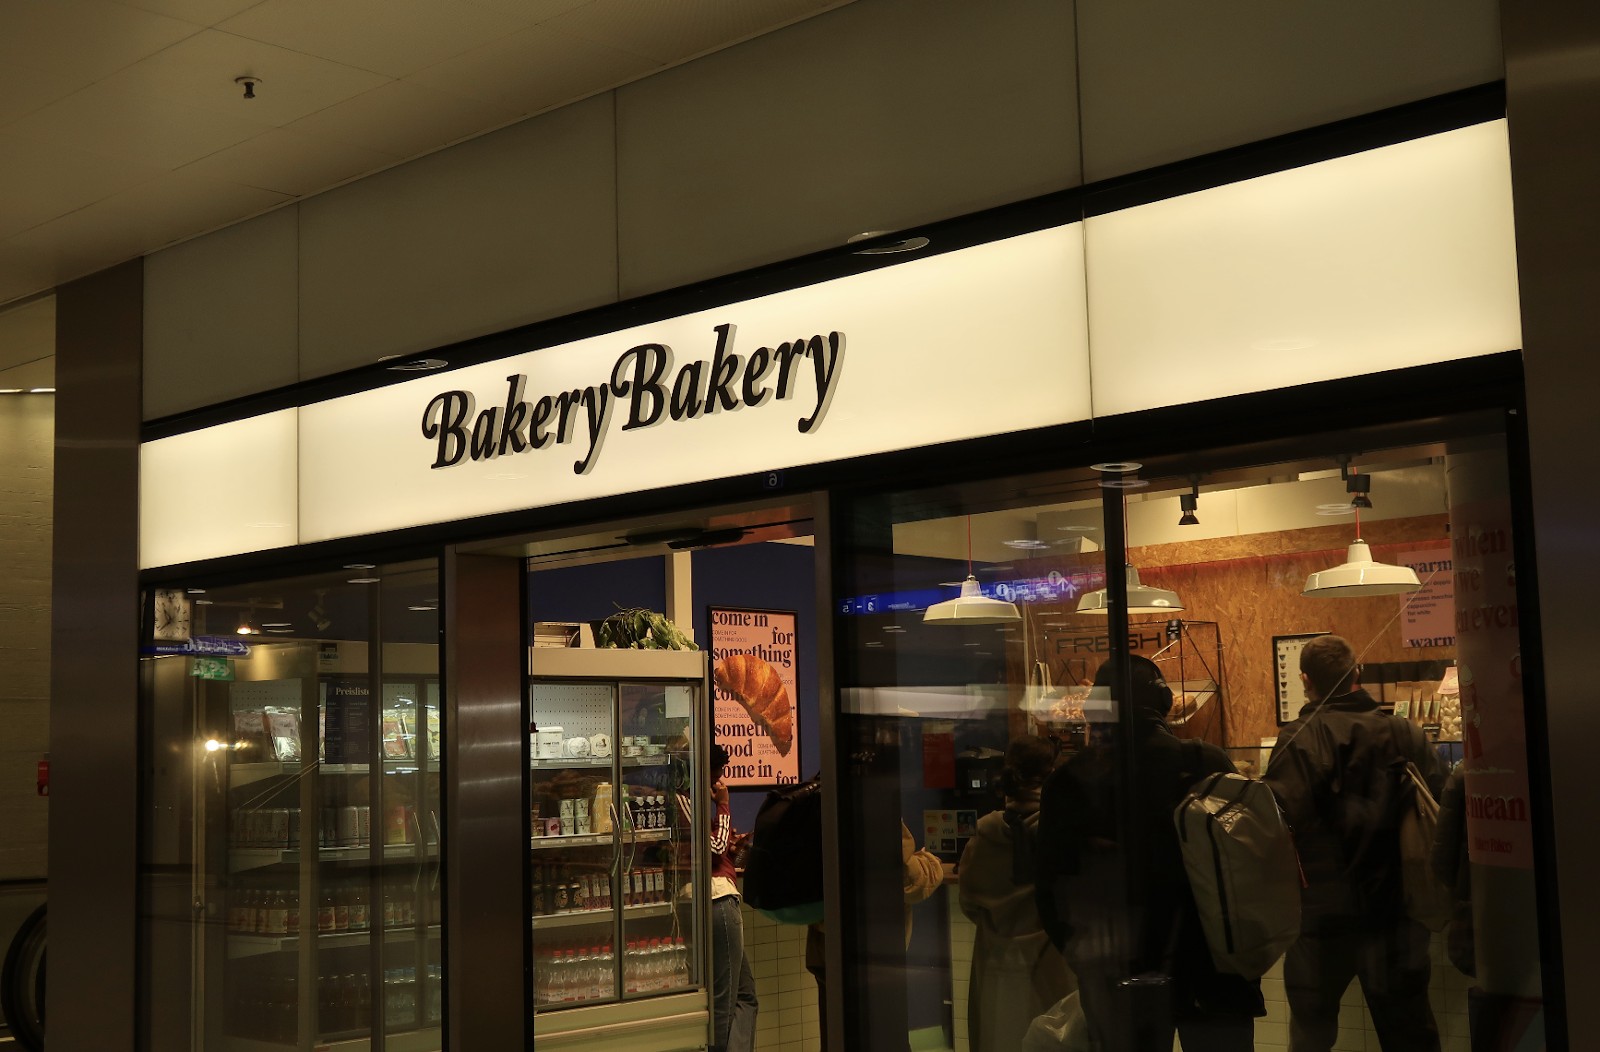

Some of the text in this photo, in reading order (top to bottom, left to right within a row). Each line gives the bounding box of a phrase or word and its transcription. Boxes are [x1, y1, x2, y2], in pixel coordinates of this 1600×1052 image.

[712, 612, 751, 626] come
[772, 627, 794, 645] for
[722, 738, 753, 757] ood
[723, 759, 772, 778] ome in
